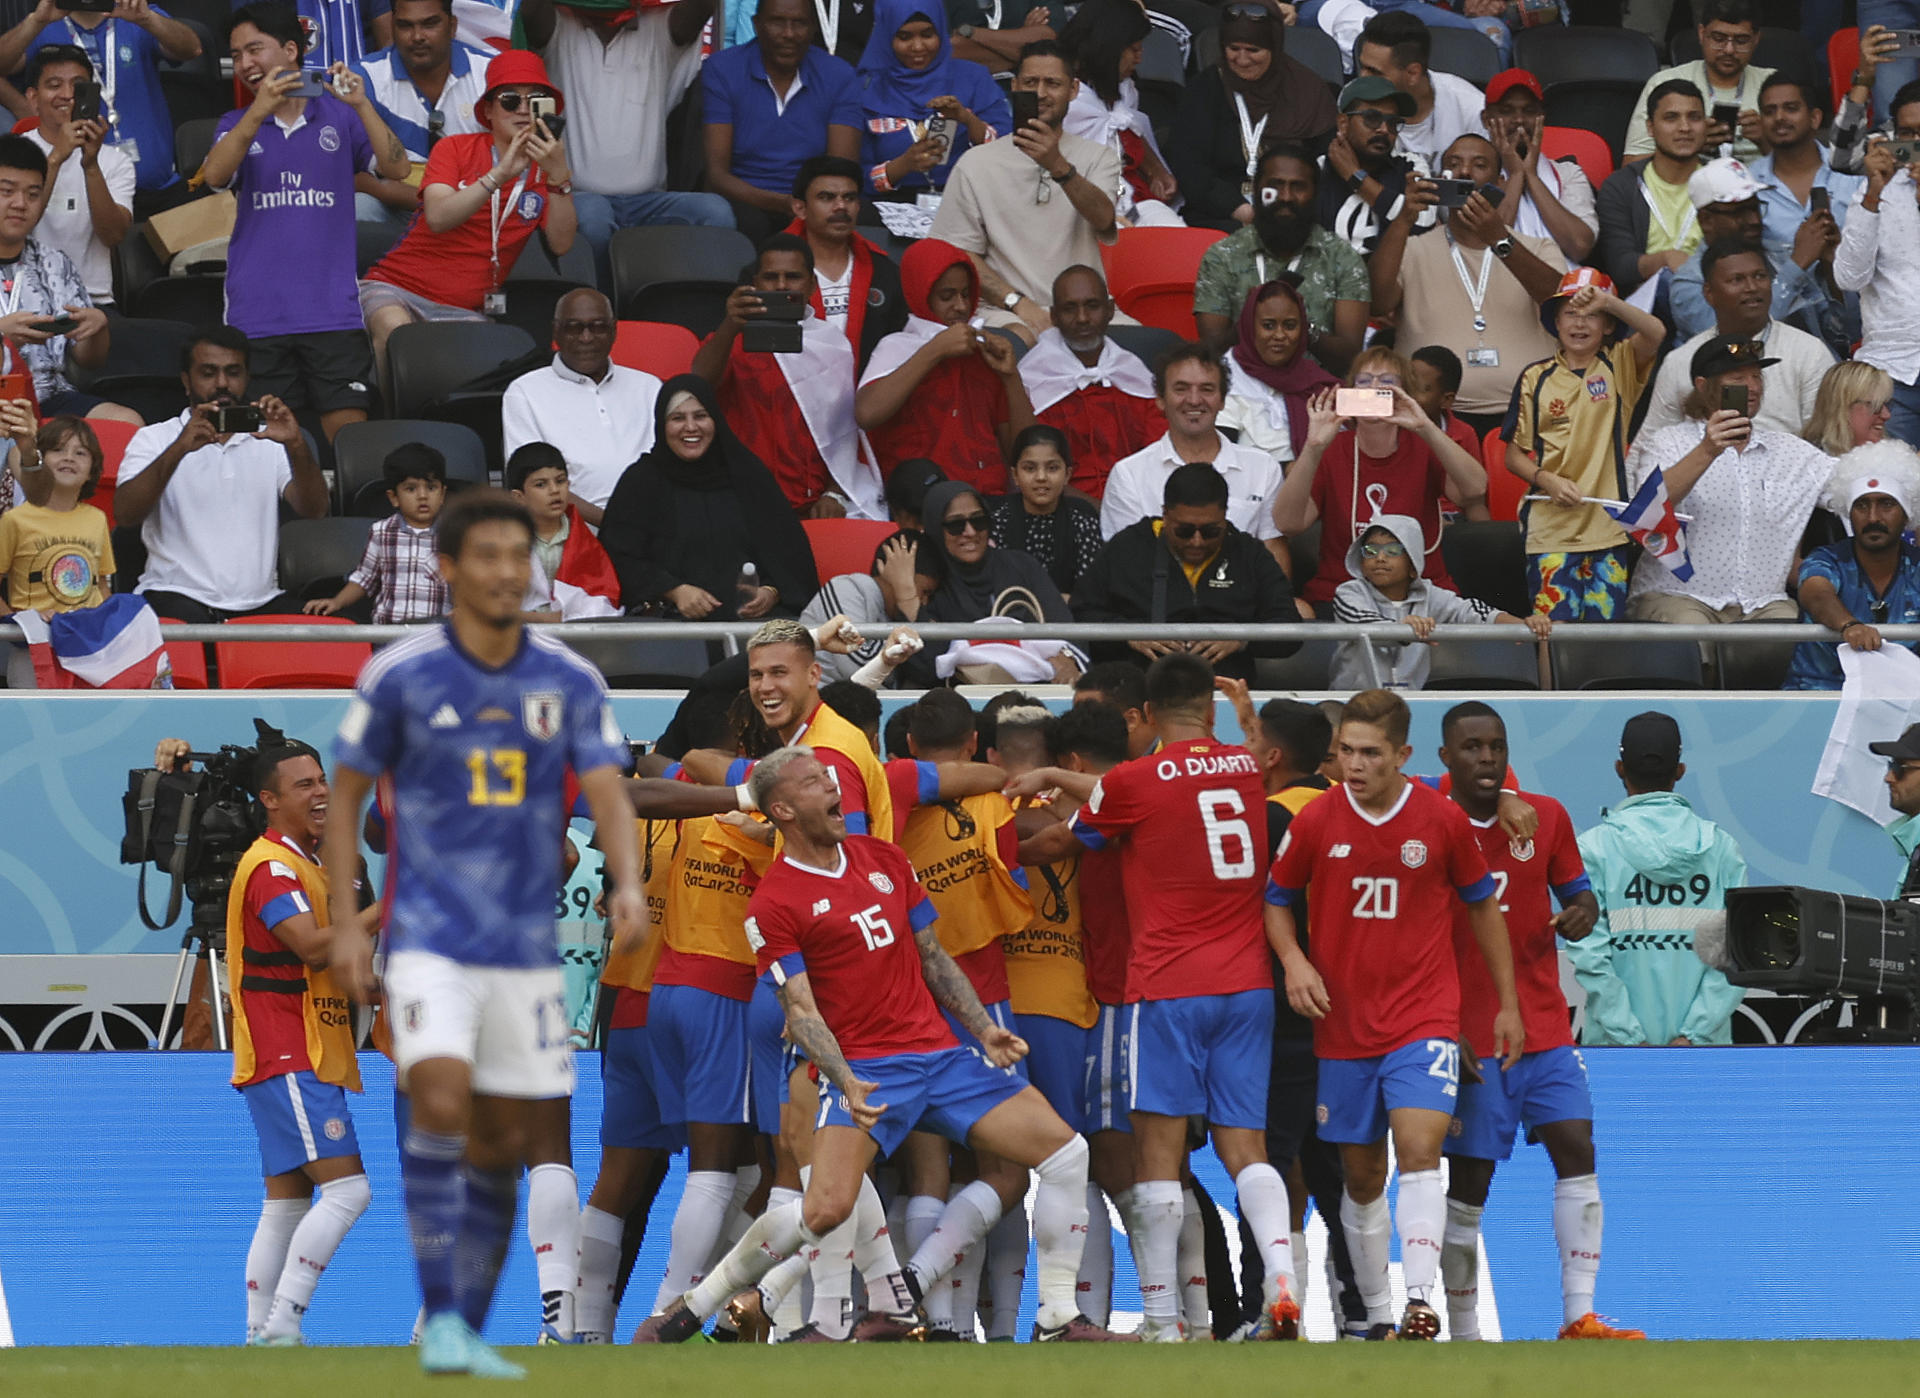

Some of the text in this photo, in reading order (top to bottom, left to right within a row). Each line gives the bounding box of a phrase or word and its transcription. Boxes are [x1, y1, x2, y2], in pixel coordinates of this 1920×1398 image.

[253, 187, 335, 210] Emirates
[280, 171, 302, 188] Fly
[465, 748, 527, 807] 13
[1157, 754, 1259, 781] O. DUARTE
[1197, 788, 1256, 880] 6
[1352, 876, 1398, 919] 20
[1624, 873, 1710, 905] 4069
[850, 904, 895, 951] 15
[1427, 1039, 1459, 1084] 20
